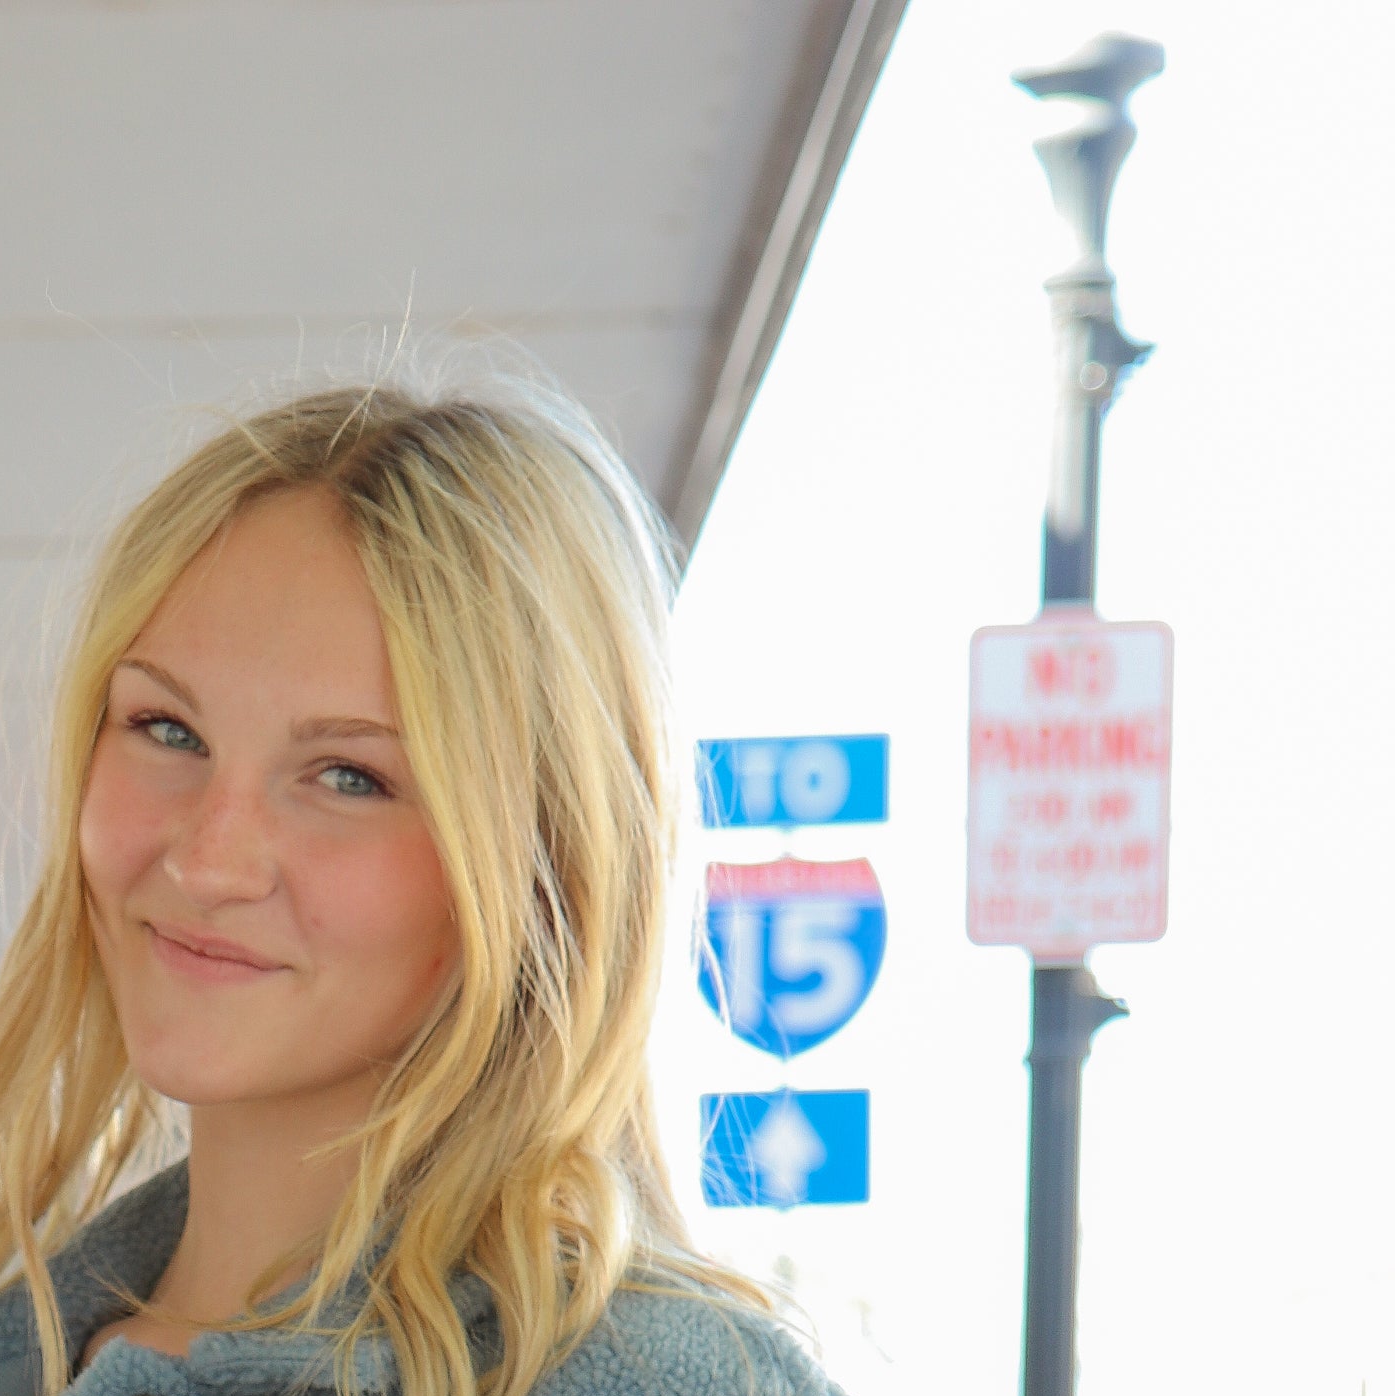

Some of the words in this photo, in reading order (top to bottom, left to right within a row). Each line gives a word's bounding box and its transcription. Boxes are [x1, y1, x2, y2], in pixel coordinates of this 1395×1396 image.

[1028, 642, 1115, 704] NO
[970, 715, 1168, 776] PARKING
[730, 741, 851, 824] TO
[716, 901, 865, 1035] 15
